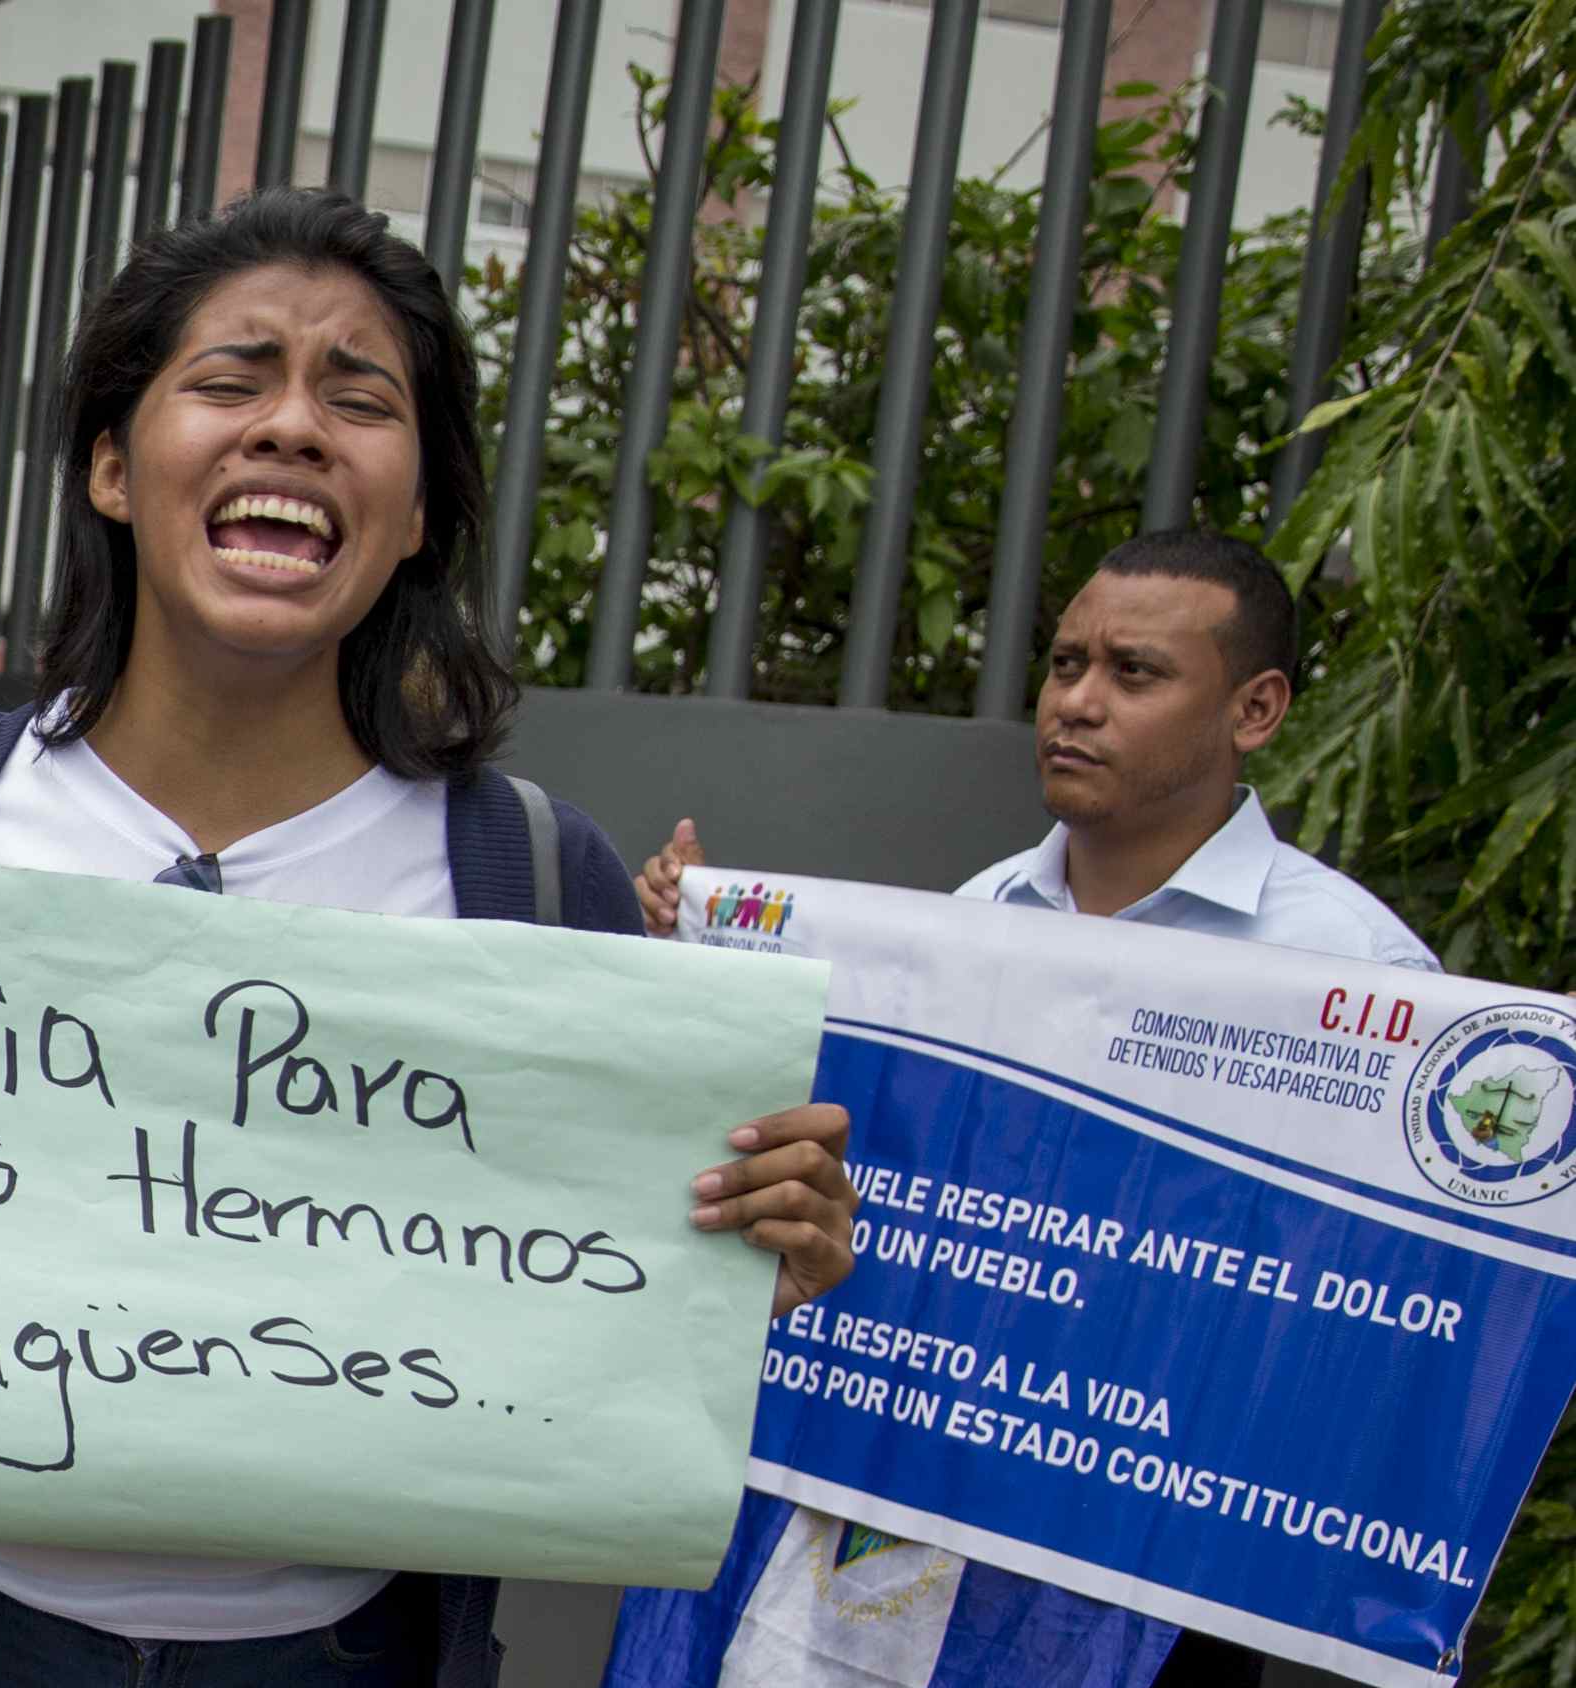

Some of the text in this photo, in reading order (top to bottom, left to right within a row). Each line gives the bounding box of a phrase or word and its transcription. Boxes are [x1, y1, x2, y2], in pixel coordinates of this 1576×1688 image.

[204, 978, 476, 1153] Para
[1107, 1036, 1386, 1114] DETENIDOS Y DESAPARECIDOS
[1131, 1007, 1396, 1082] COMISION INVESTIGATIVA DE
[1320, 987, 1421, 1048] C.I.D.
[1409, 1096, 1423, 1144] UNIDAD
[1416, 1034, 1460, 1091] NACIONAL
[1462, 1021, 1480, 1035] DE
[107, 1121, 649, 1296] Hermanos
[1447, 1177, 1510, 1201] UNANIC
[875, 1224, 928, 1269] UN
[929, 1241, 1085, 1311] PUEBLO.
[935, 1182, 1124, 1260] RESPIRAR
[1130, 1229, 1241, 1289] ANTE
[1246, 1254, 1300, 1305] EL
[1311, 1270, 1465, 1343] DOLOR
[787, 1303, 1173, 1439] EL RESPETO A LA VIDA
[823, 1365, 889, 1416] POR
[892, 1384, 941, 1431] UN
[944, 1399, 1098, 1477] ESTADO
[1103, 1443, 1476, 1590] CONSTITUCIONAL.
